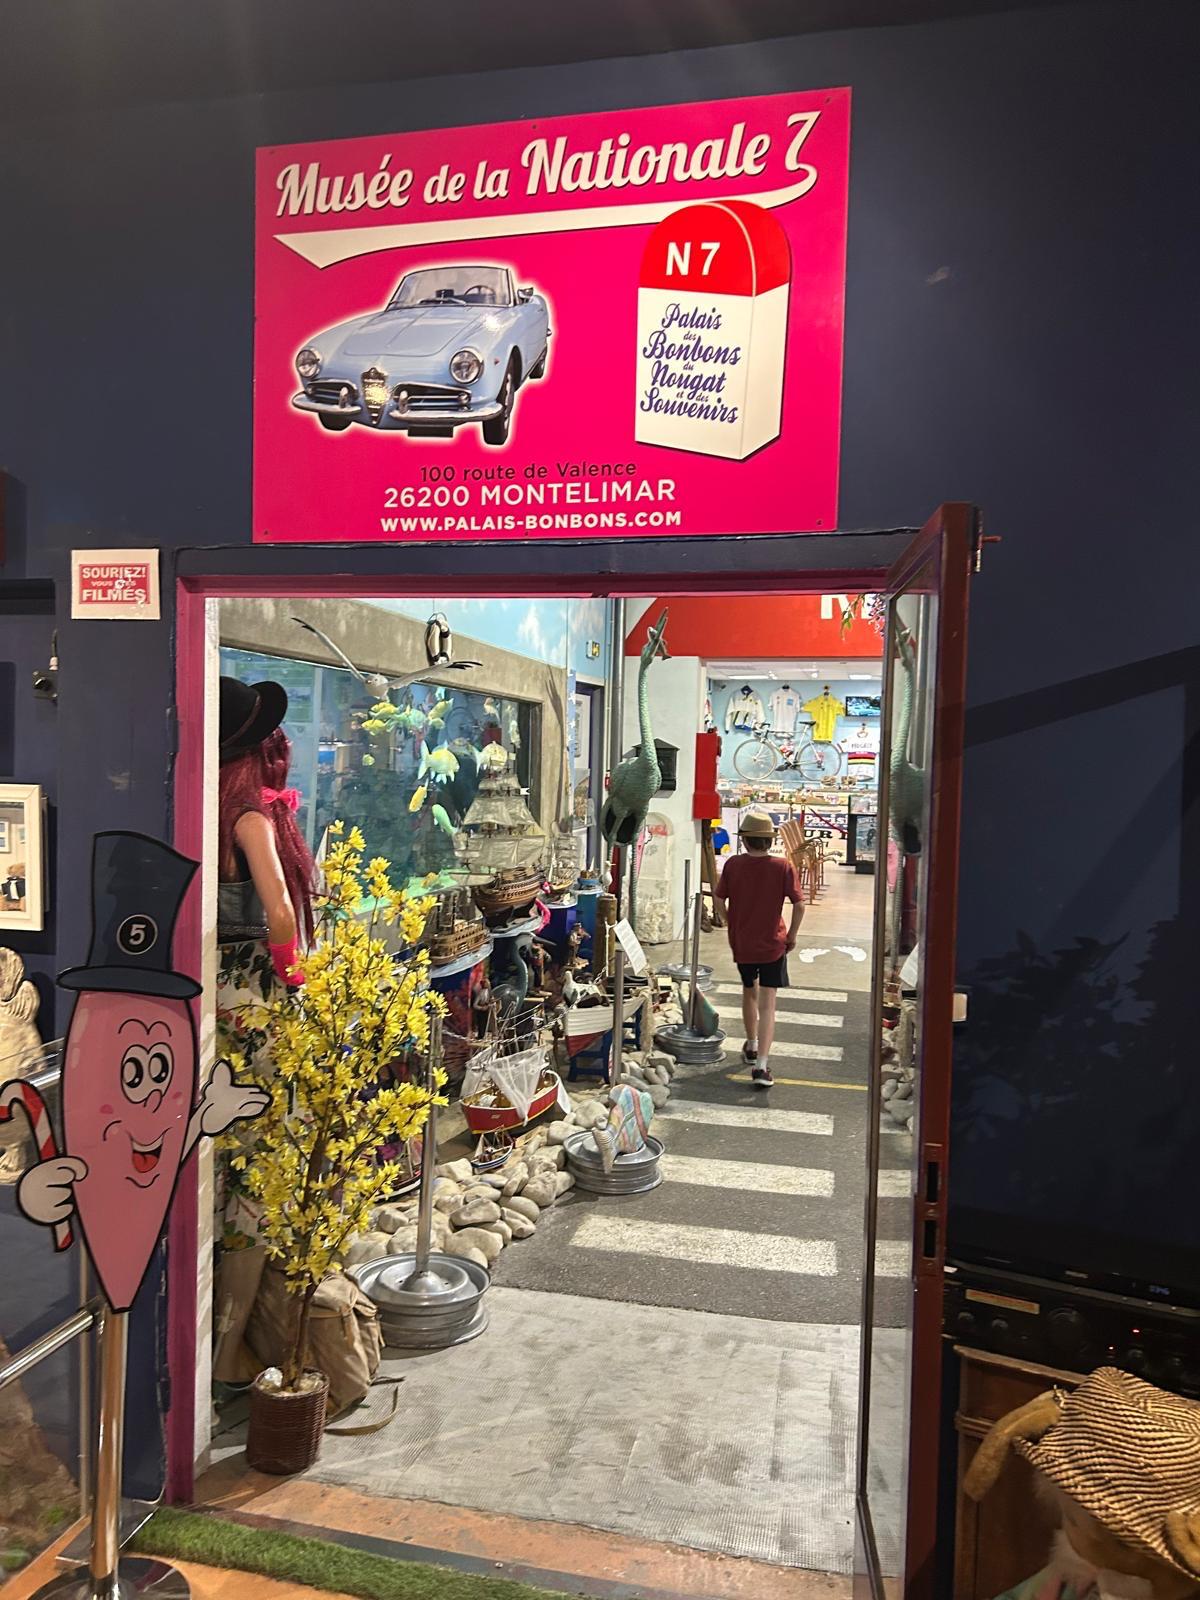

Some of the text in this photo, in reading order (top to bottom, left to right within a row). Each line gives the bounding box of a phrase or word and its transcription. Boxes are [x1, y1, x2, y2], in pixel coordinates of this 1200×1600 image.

[276, 110, 822, 216] Musée de la Nationale 7
[666, 242, 720, 276] N 7
[661, 303, 722, 330] Palais
[683, 331, 697, 341] des
[642, 329, 741, 365] Bonbons
[683, 361, 695, 371] du
[651, 360, 727, 400] Nougat
[640, 387, 738, 424] Souvenirs
[676, 391, 709, 402] et des
[420, 461, 637, 482] 100 route de Valence
[384, 479, 676, 508] 26200 MONTELIMAR
[380, 511, 682, 532] WWW.PALAIS-BONBONS.COM
[82, 566, 146, 579] SOURIEZ!
[82, 586, 146, 602] FILMÉS
[129, 924, 146, 945] 5
